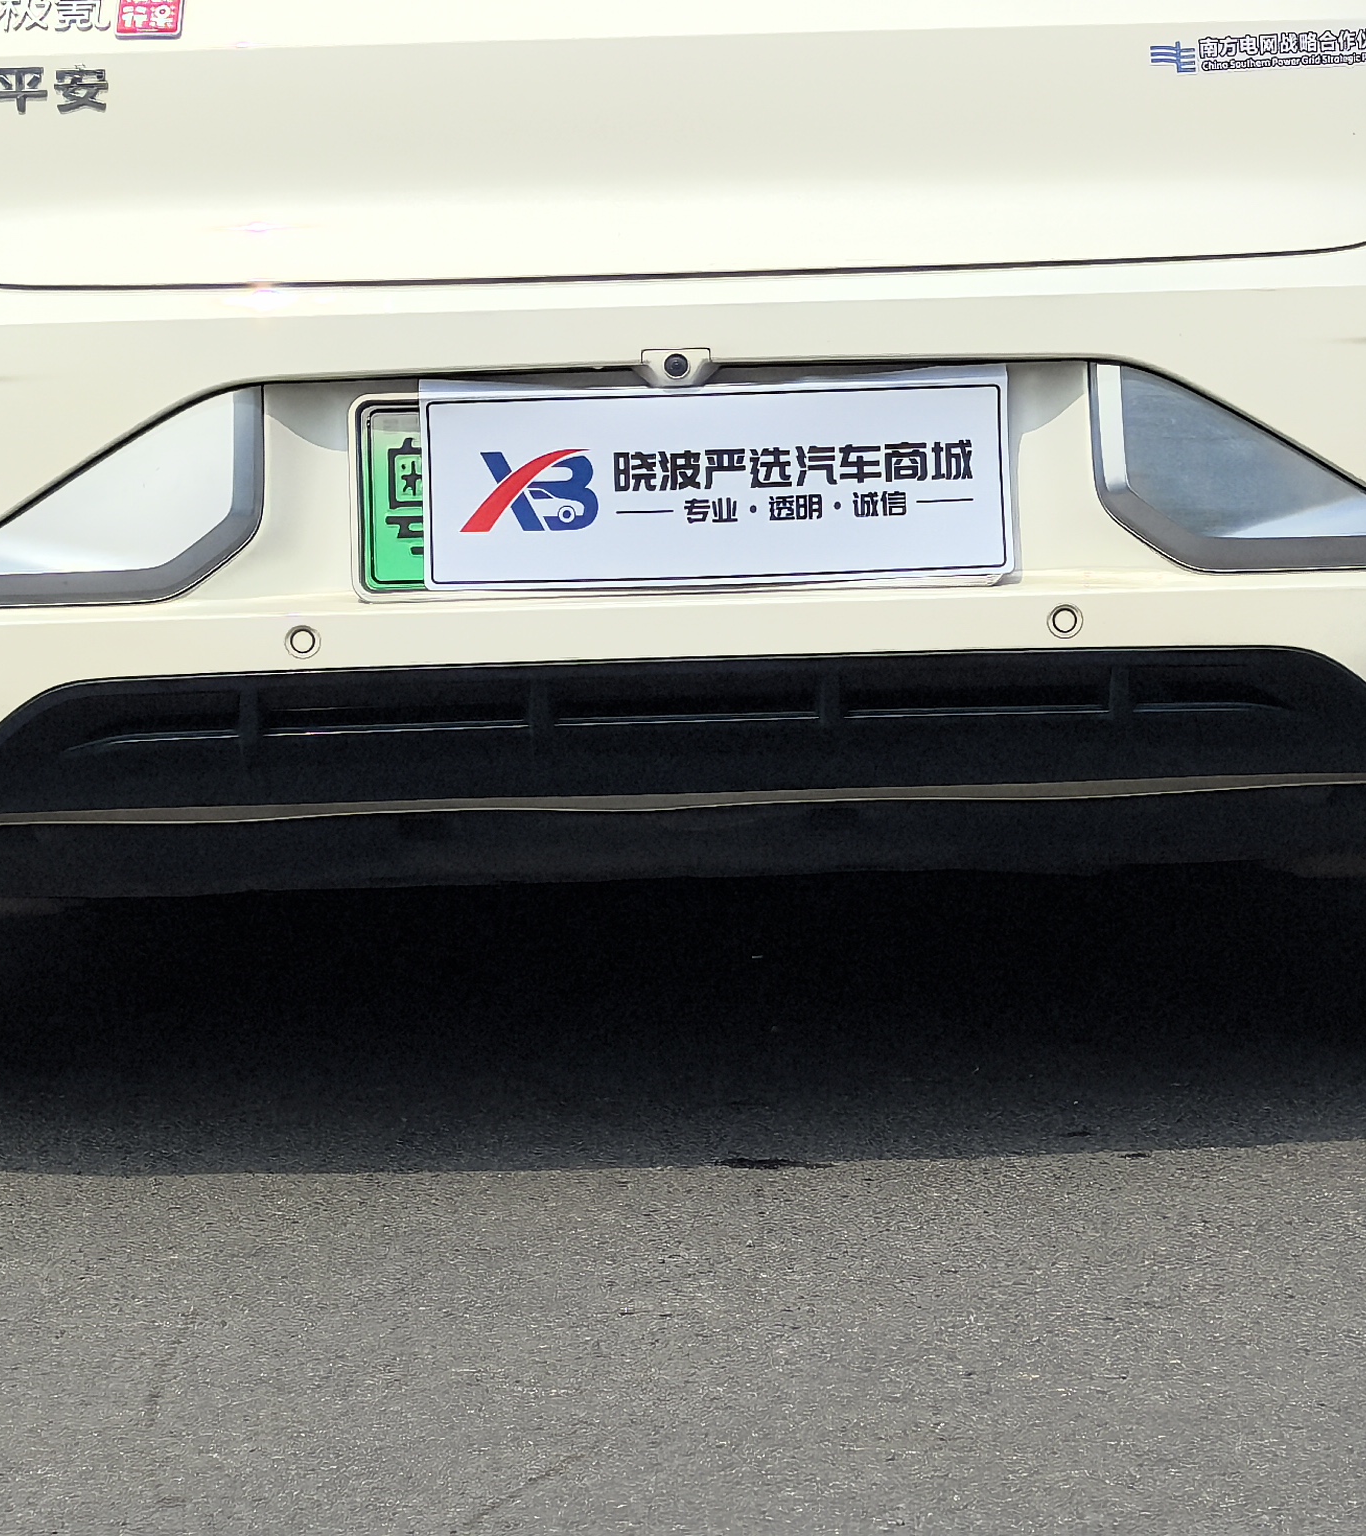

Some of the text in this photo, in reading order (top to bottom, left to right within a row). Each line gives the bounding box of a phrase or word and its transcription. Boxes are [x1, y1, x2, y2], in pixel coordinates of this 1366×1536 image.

[612, 438, 975, 493] 晓波严选汽车商城
